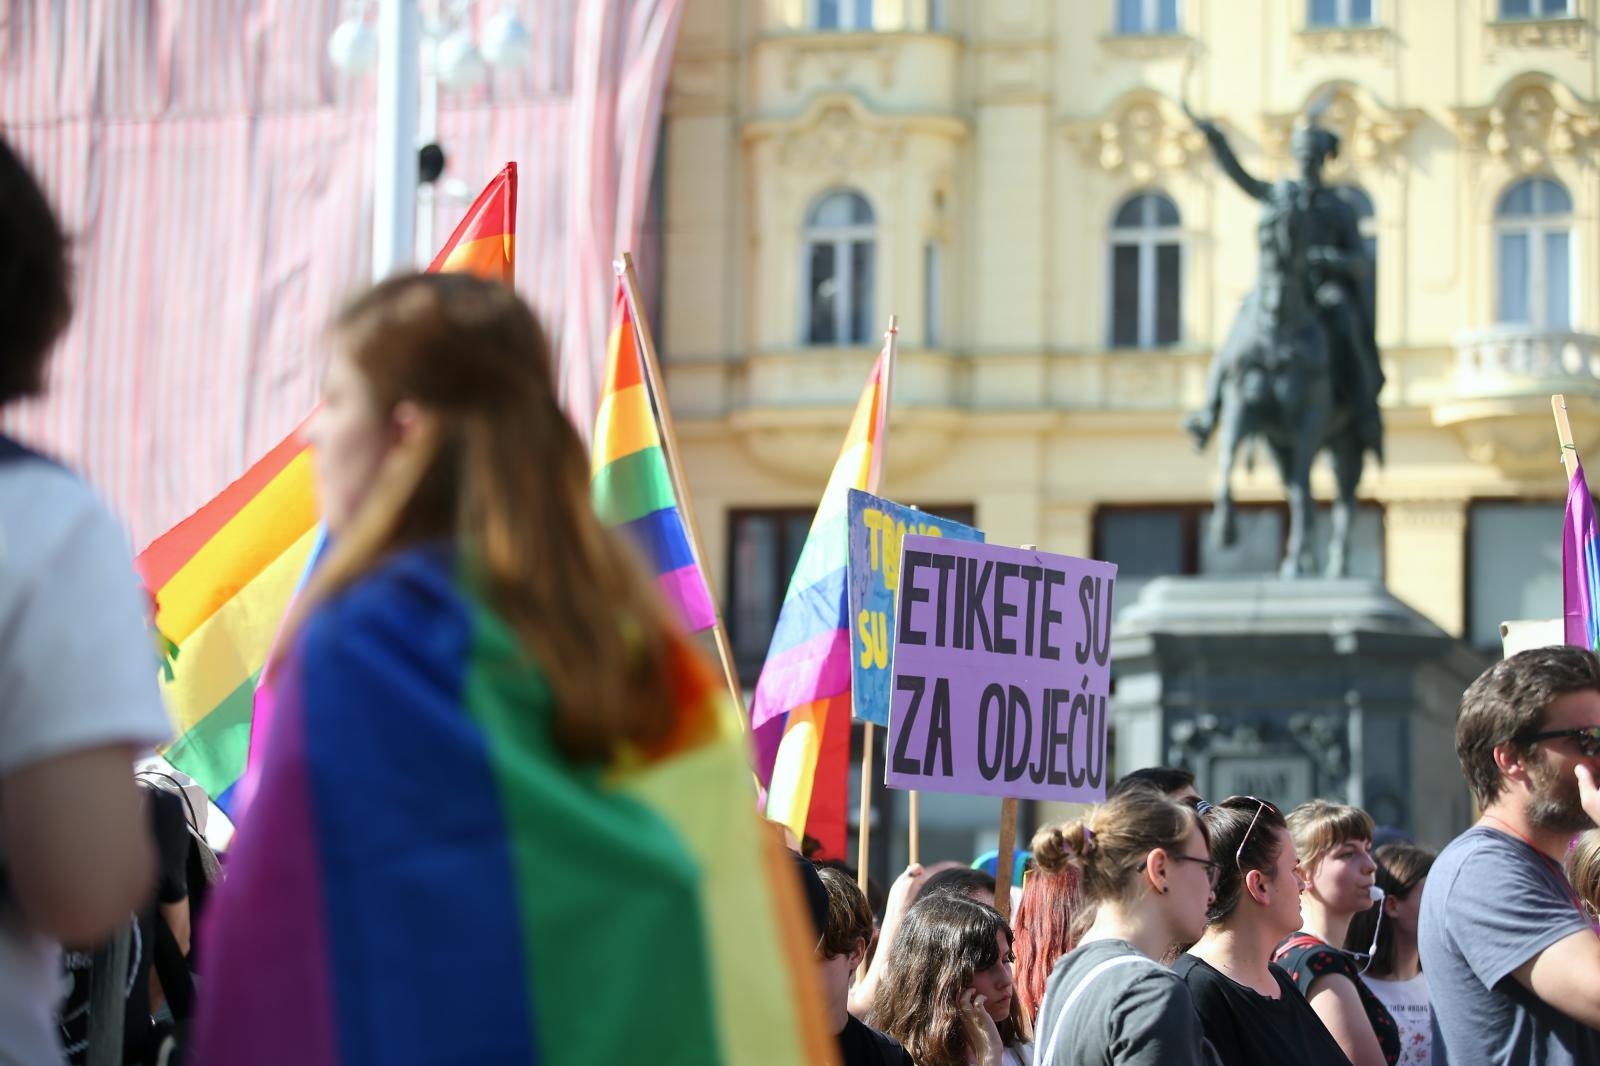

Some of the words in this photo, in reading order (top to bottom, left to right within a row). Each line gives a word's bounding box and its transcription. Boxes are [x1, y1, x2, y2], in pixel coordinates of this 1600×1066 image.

[858, 609, 888, 670] SU
[900, 550, 1065, 660] ETIKETE
[1075, 575, 1114, 667] SU
[892, 675, 953, 777] ZA
[977, 674, 1106, 789] ODJEĆU
